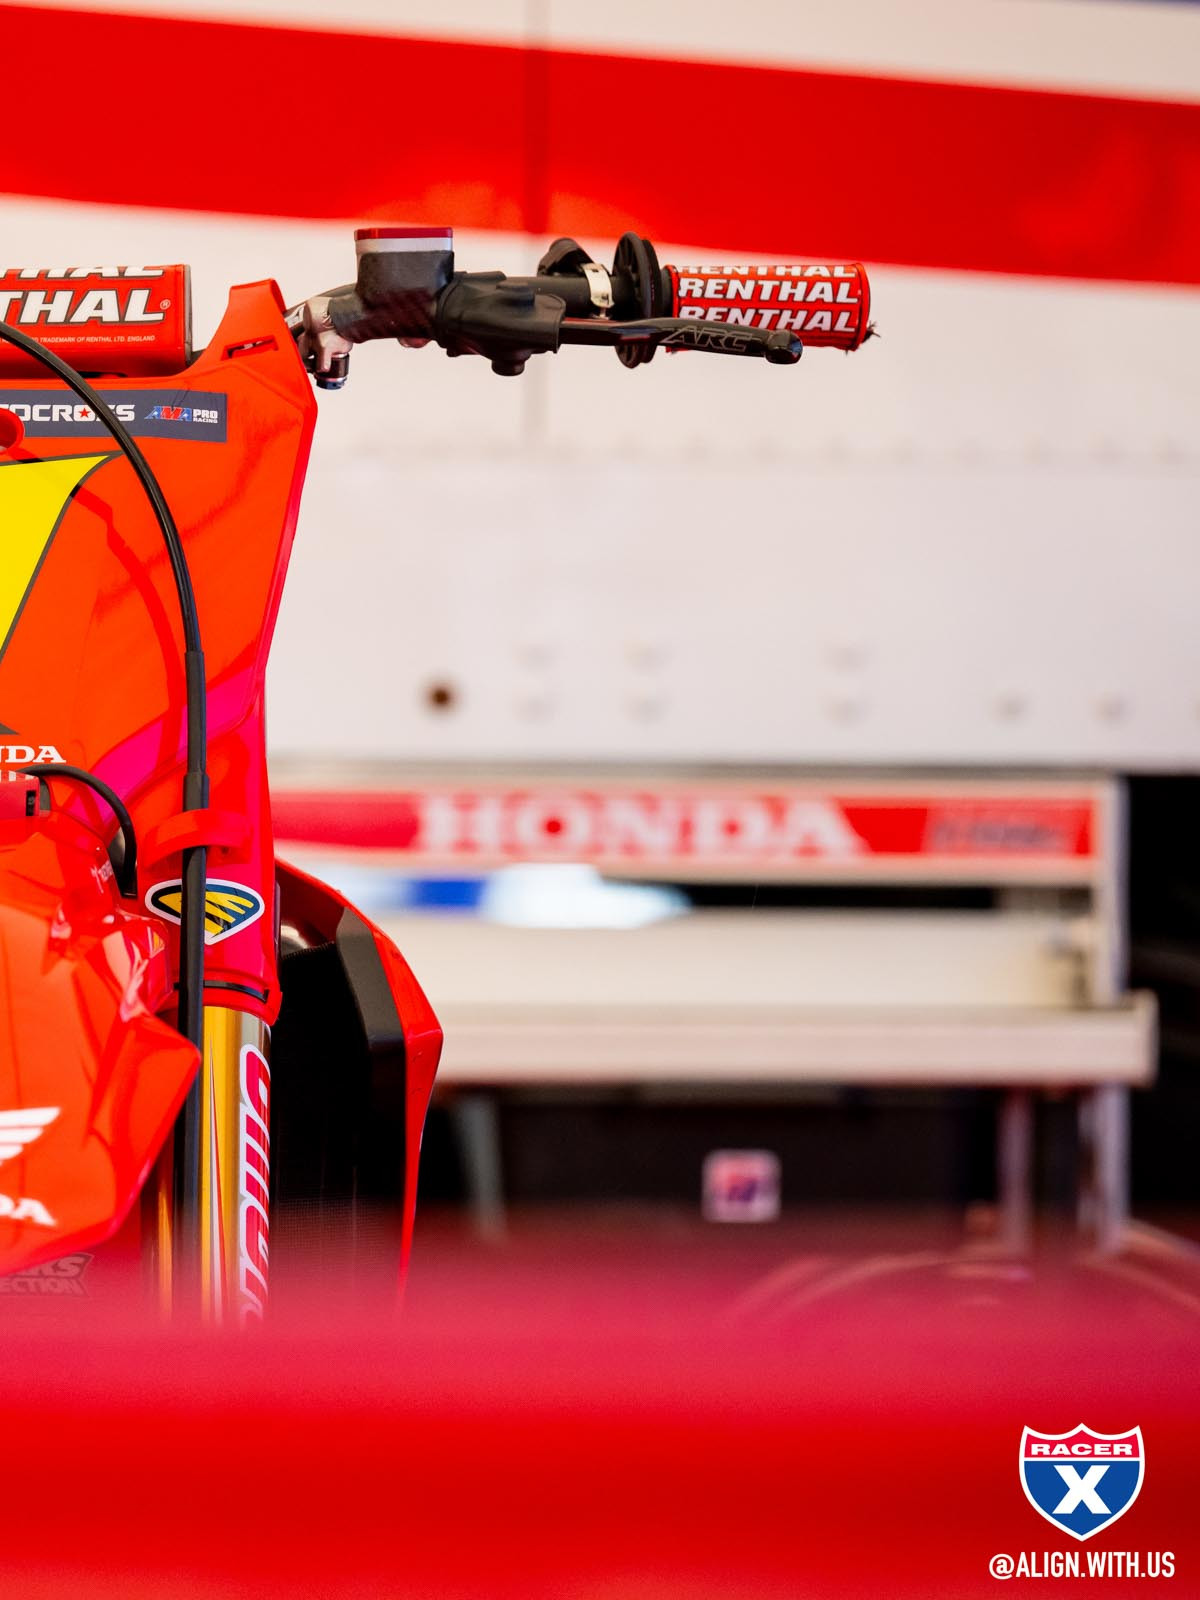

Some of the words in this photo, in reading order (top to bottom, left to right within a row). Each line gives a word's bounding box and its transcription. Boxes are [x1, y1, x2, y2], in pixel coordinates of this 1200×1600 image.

[678, 277, 858, 304] RENTHAL
[659, 324, 753, 352] ARC
[144, 405, 193, 422] AMA
[192, 408, 219, 418] PRO
[416, 796, 865, 861] HONDA
